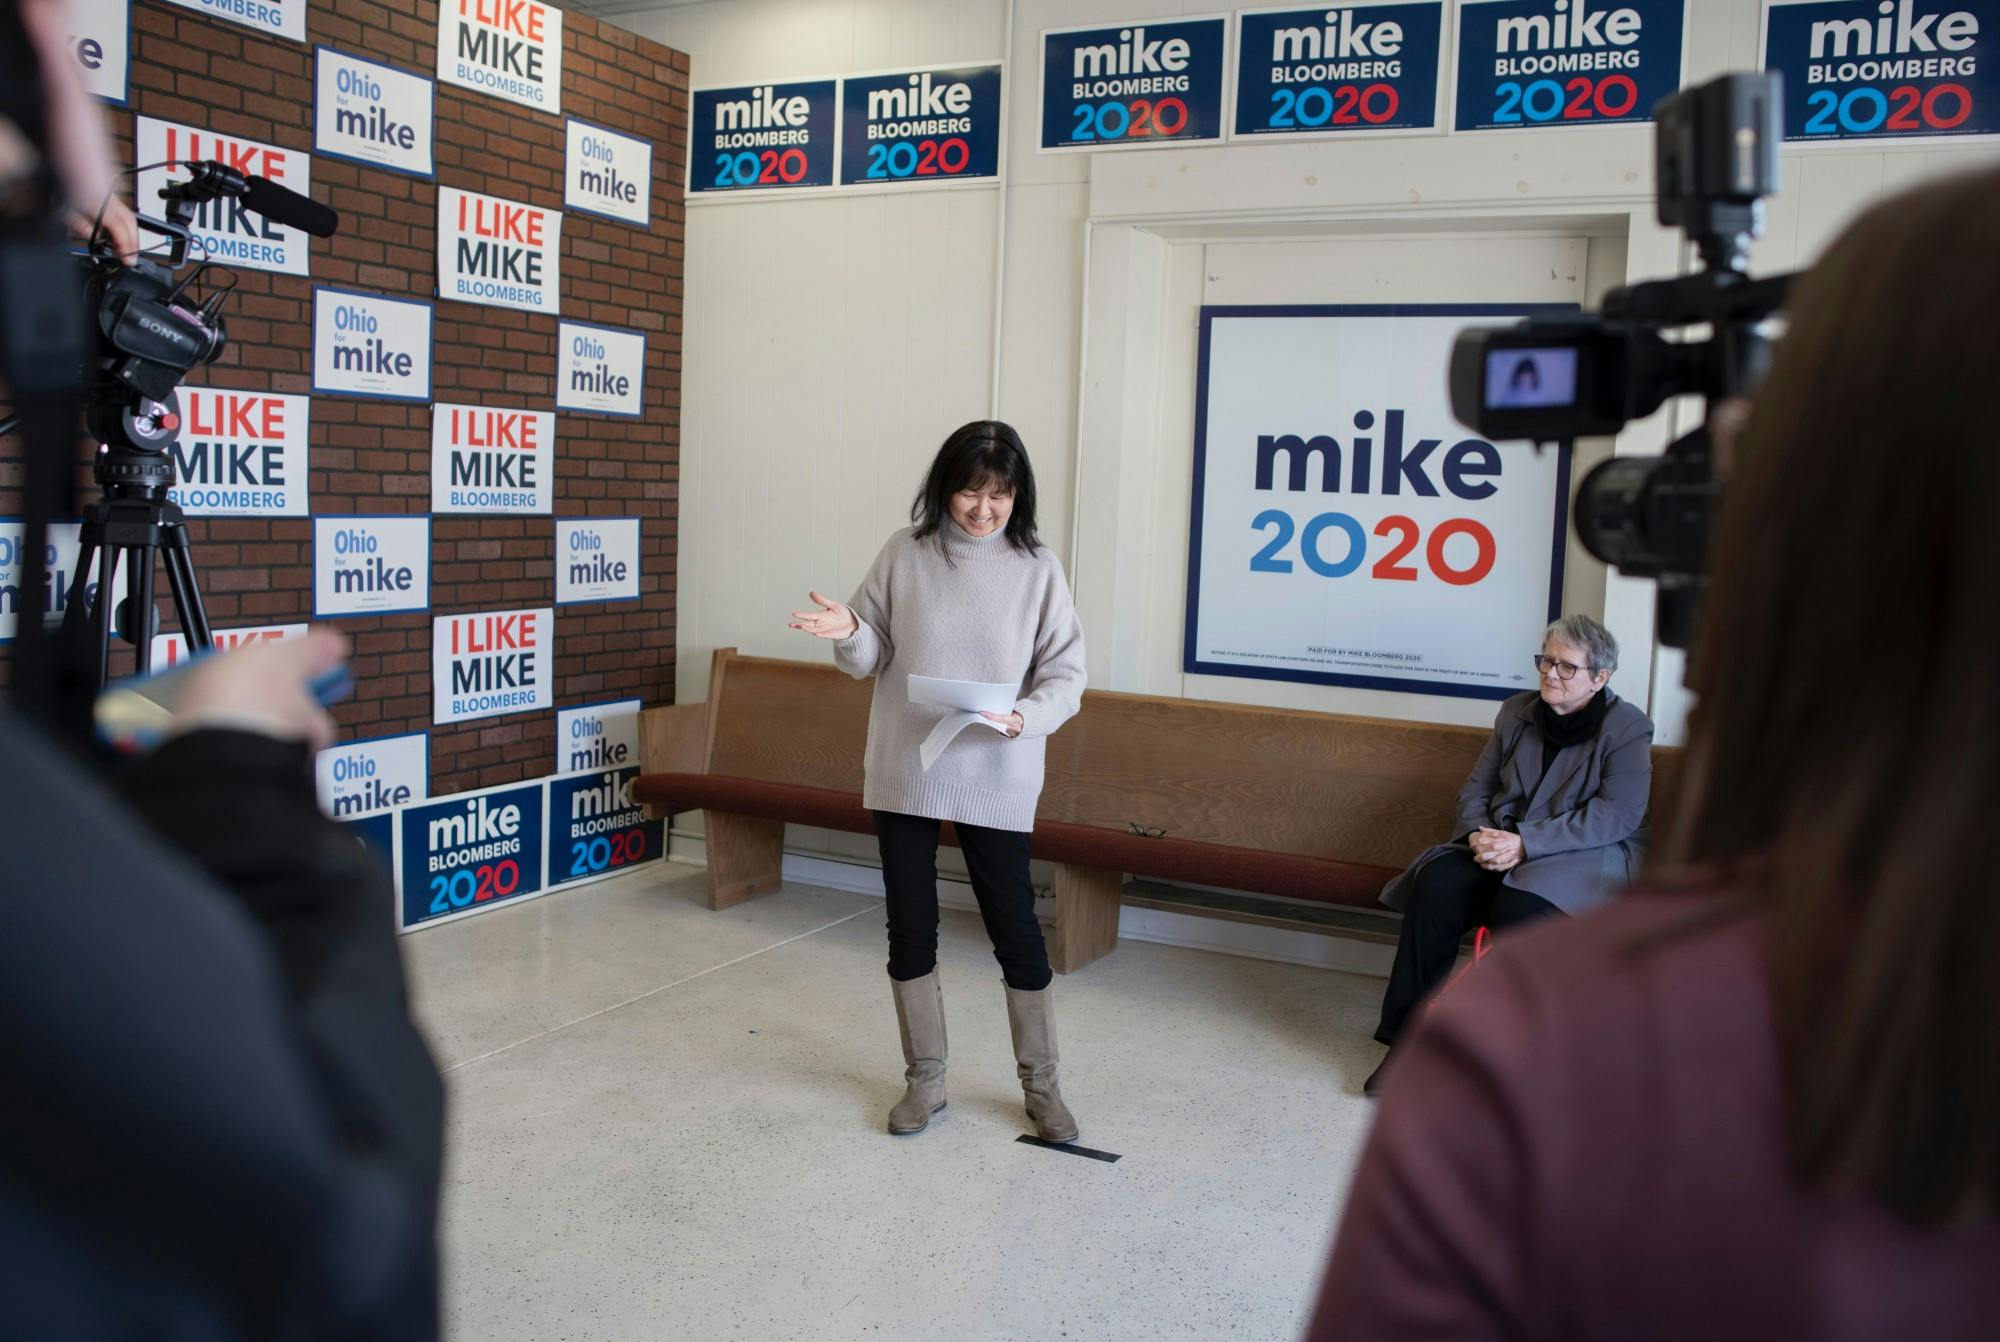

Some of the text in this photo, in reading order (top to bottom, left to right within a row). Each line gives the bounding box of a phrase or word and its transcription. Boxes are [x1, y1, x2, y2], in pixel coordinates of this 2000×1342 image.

[203, 0, 282, 27] MBERG
[476, 0, 545, 43] LIKE
[1496, 0, 1642, 53] mike
[1810, 0, 1979, 58] mike
[458, 21, 545, 83] MIKE
[1073, 28, 1191, 78] mike
[1272, 9, 1403, 62] mike
[1271, 60, 1401, 83] BLOOMBERG
[1495, 49, 1640, 76] BLOOMBERG
[1808, 55, 1977, 84] BLOOMBERG
[336, 68, 381, 101] Ohio
[457, 64, 544, 102] BLOOMBERG
[868, 73, 972, 120] mike
[1073, 75, 1190, 99] BLOOMBERG
[1493, 74, 1639, 123] 2020
[715, 86, 810, 131] mike
[1071, 97, 1189, 140] 2020
[1269, 83, 1399, 127] 2020
[1804, 83, 1974, 134] 2020
[336, 105, 415, 150] mike
[715, 129, 809, 149] BLOOMBERG
[867, 117, 971, 140] BLOOMBERG
[167, 127, 176, 172] I
[581, 136, 613, 164] Ohio
[715, 148, 808, 186] 2020
[867, 138, 970, 179] 2020
[580, 168, 637, 204] mike
[458, 195, 544, 247] I LIKE
[164, 234, 285, 264] BOOMBERG
[457, 237, 542, 287] MIKE
[457, 280, 542, 305] BLOOMBERG
[139, 317, 183, 343] SONY
[334, 333, 346, 343] for
[335, 305, 377, 335] Ohio
[333, 339, 413, 377] mike
[573, 336, 605, 361] Ohio
[571, 364, 629, 396] mike
[190, 392, 285, 439] LIKE
[451, 409, 537, 449] I LIKE
[168, 441, 285, 486] MIKE
[451, 451, 536, 488] MIKE
[1255, 409, 1503, 500] mike
[167, 490, 285, 508] BLOOMBERG
[450, 491, 537, 508] BLOOMBERG
[335, 529, 377, 554] Ohio
[570, 529, 601, 551] Ohio
[1249, 509, 1496, 586] 2020
[334, 557, 413, 593] mike
[335, 557, 346, 567] for
[569, 553, 627, 585] mike
[452, 613, 537, 655] I LIKE
[452, 652, 536, 696] MIKE
[1364, 652, 1403, 660] BLOOMBERG
[452, 690, 536, 714] BLOOMBERG
[572, 716, 603, 738] Ohio
[333, 754, 375, 782] Ohio
[571, 737, 627, 771] mike
[333, 779, 411, 816] mike
[572, 771, 641, 819] mik
[429, 797, 521, 852] mike
[571, 811, 646, 838] BLOOMBERG
[429, 838, 521, 873] BLOOMBERG
[571, 829, 645, 876] 2020
[430, 860, 519, 914] 2020
